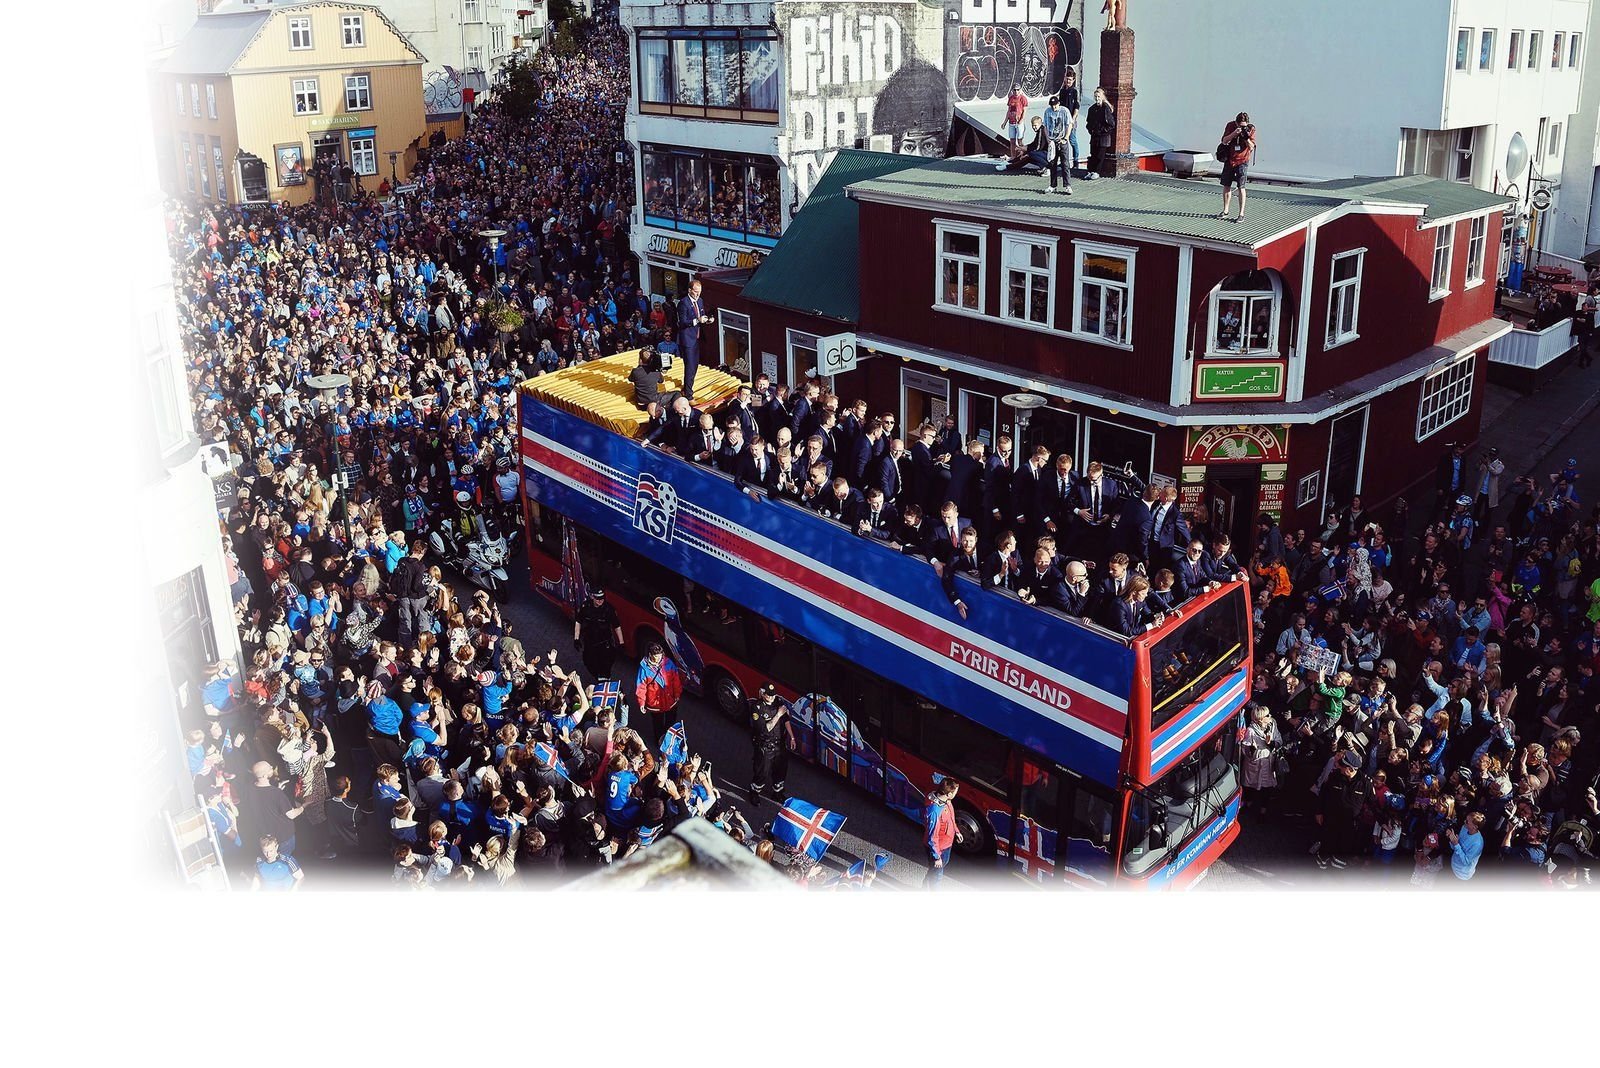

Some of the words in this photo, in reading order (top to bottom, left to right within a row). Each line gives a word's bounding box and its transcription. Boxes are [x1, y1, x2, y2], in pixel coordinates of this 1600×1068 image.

[648, 234, 695, 258] SUBWAY
[1002, 423, 1011, 434] 12
[949, 641, 1000, 679] FYRIR
[1002, 662, 1072, 710] ÍSLAND
[609, 781, 618, 798] 9
